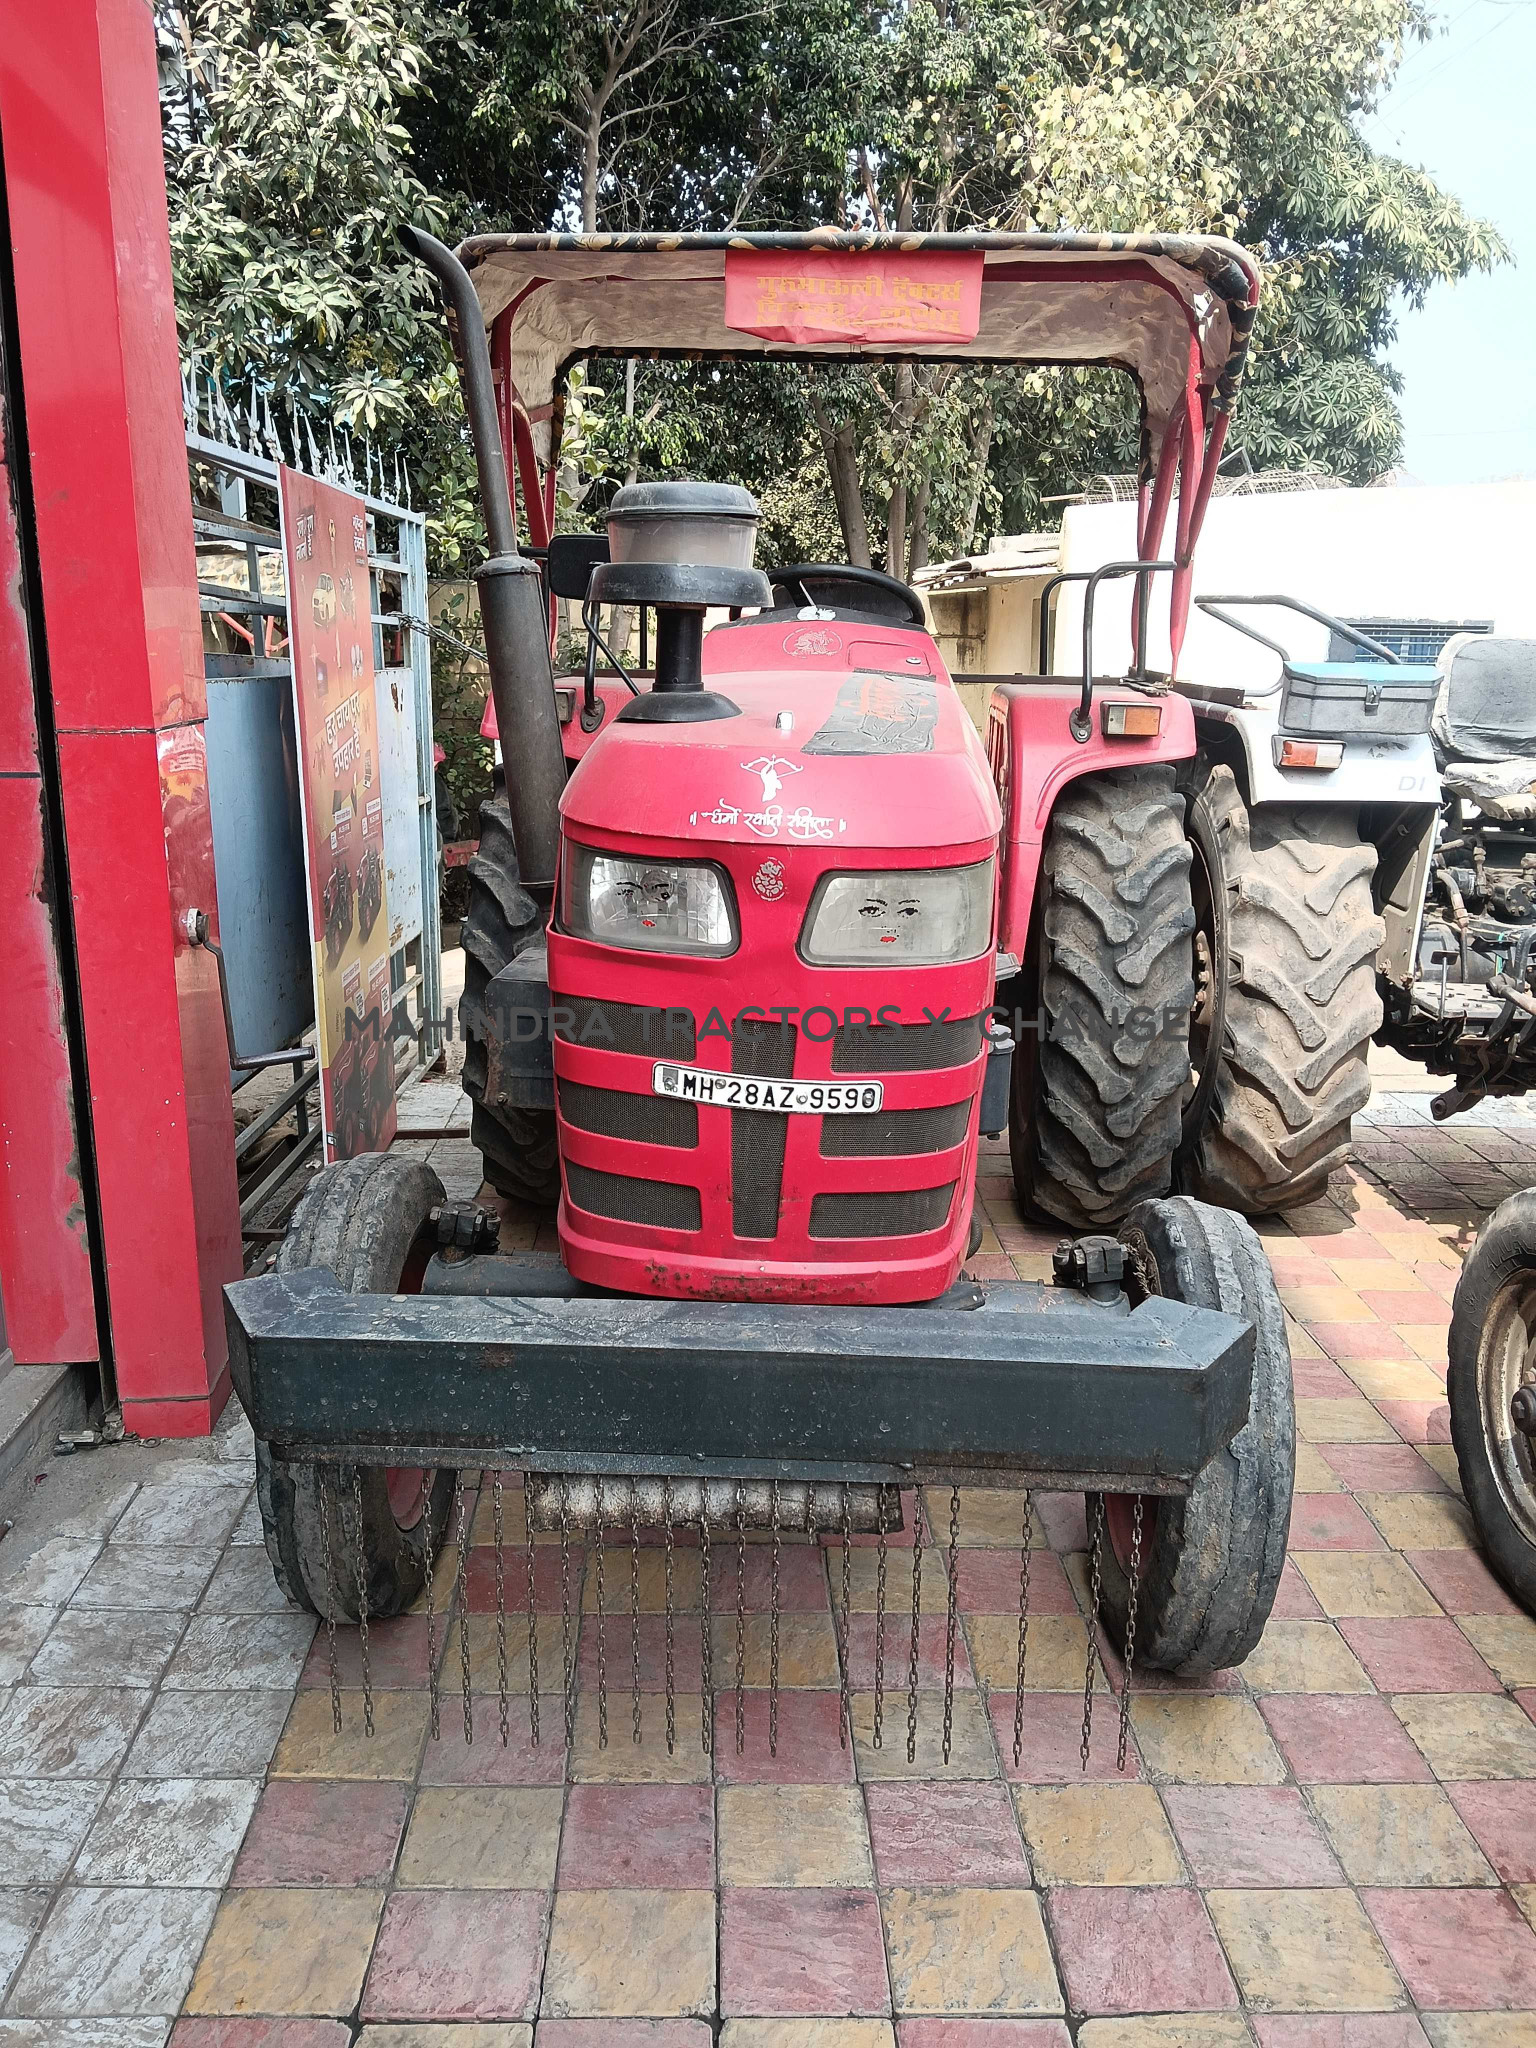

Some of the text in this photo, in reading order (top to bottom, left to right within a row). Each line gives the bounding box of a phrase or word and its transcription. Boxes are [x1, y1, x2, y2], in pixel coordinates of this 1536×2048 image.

[325, 711, 337, 745] हर
[350, 690, 360, 716] पर
[332, 736, 355, 778] उपहार
[1398, 776, 1426, 791] DI
